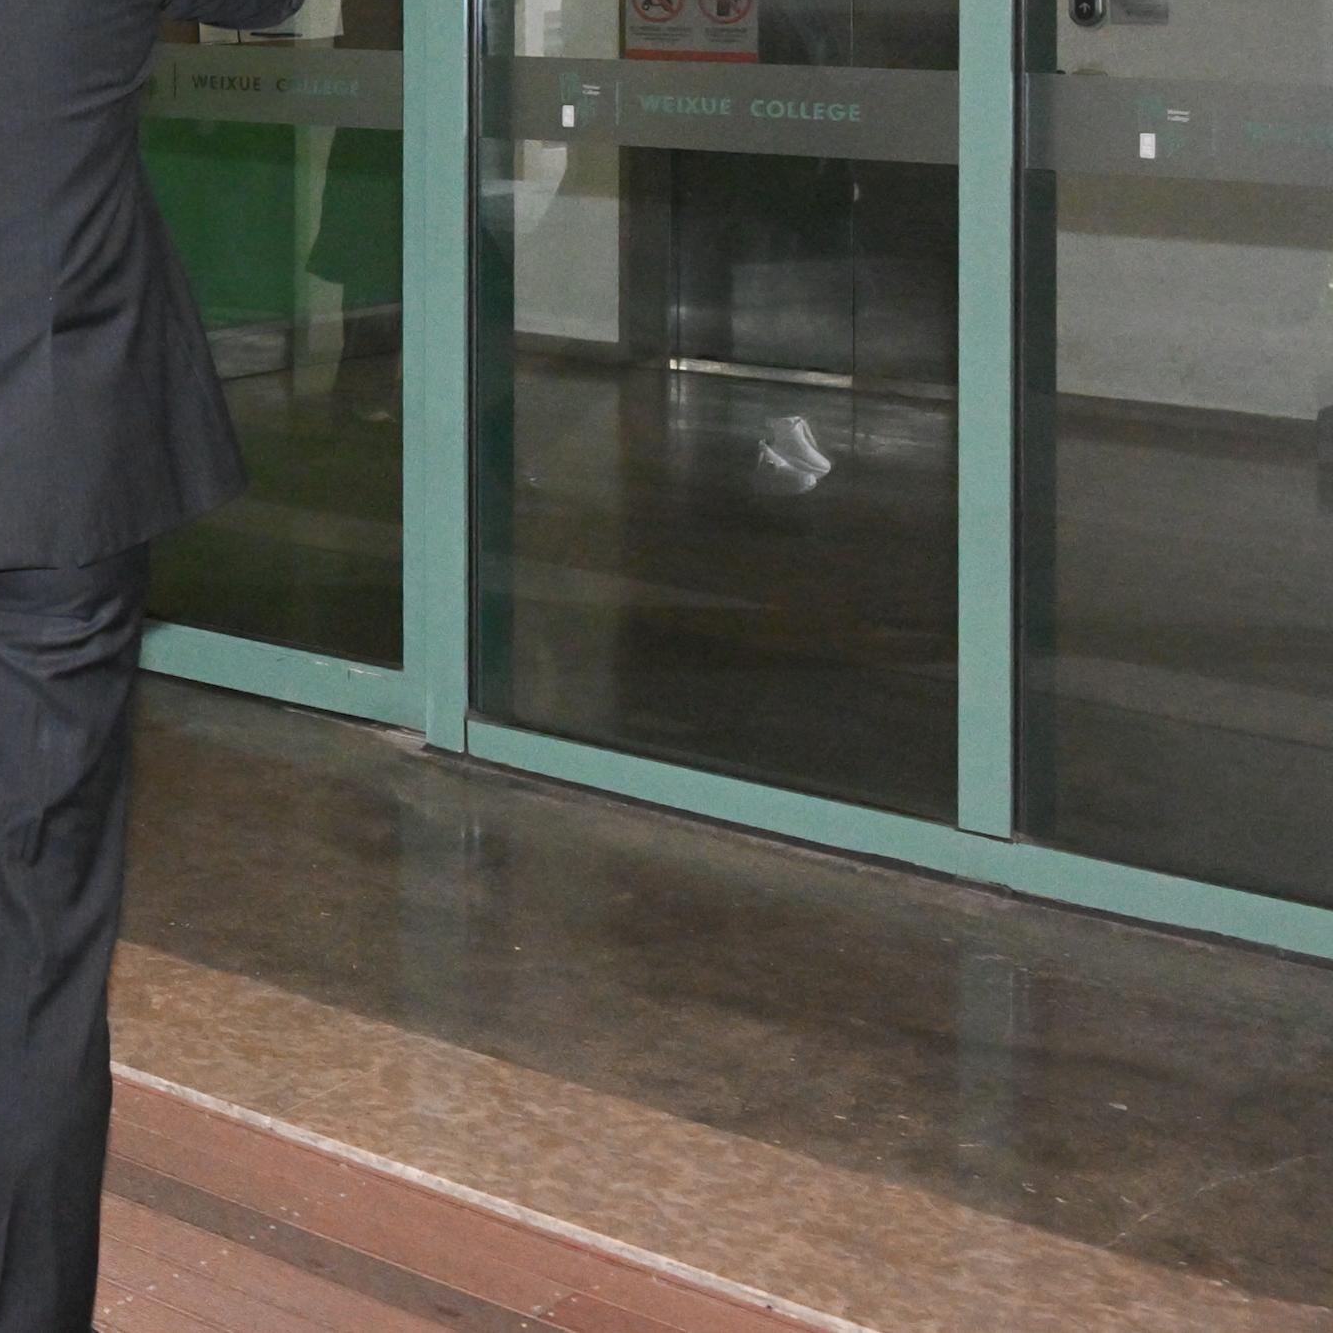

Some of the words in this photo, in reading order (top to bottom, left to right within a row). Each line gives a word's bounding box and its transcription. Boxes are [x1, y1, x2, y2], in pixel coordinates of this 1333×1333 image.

[191, 74, 261, 92] WEIXUE
[639, 93, 732, 115] WEIXUE
[749, 98, 862, 122] COLLEGE
